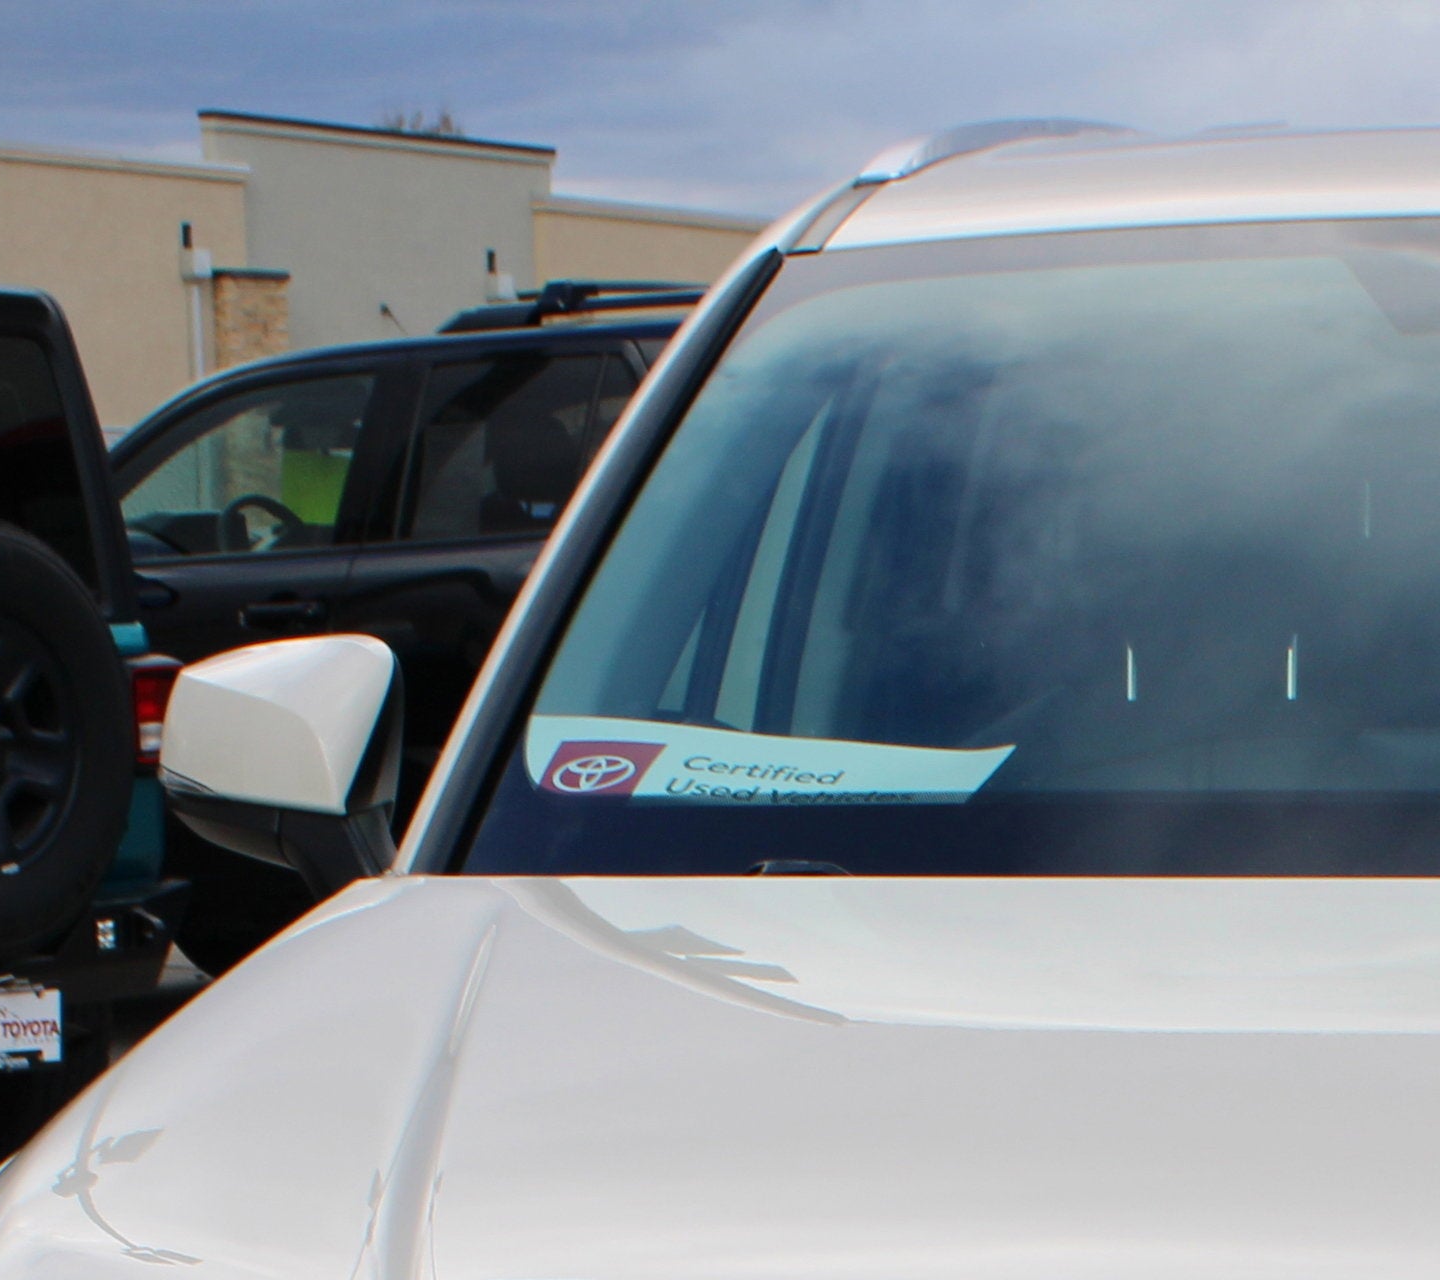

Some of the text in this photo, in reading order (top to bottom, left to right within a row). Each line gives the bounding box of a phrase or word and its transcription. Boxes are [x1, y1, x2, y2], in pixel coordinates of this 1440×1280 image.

[683, 756, 846, 785] Certified
[665, 777, 761, 802] Used
[1, 1019, 61, 1040] TOYOTA
